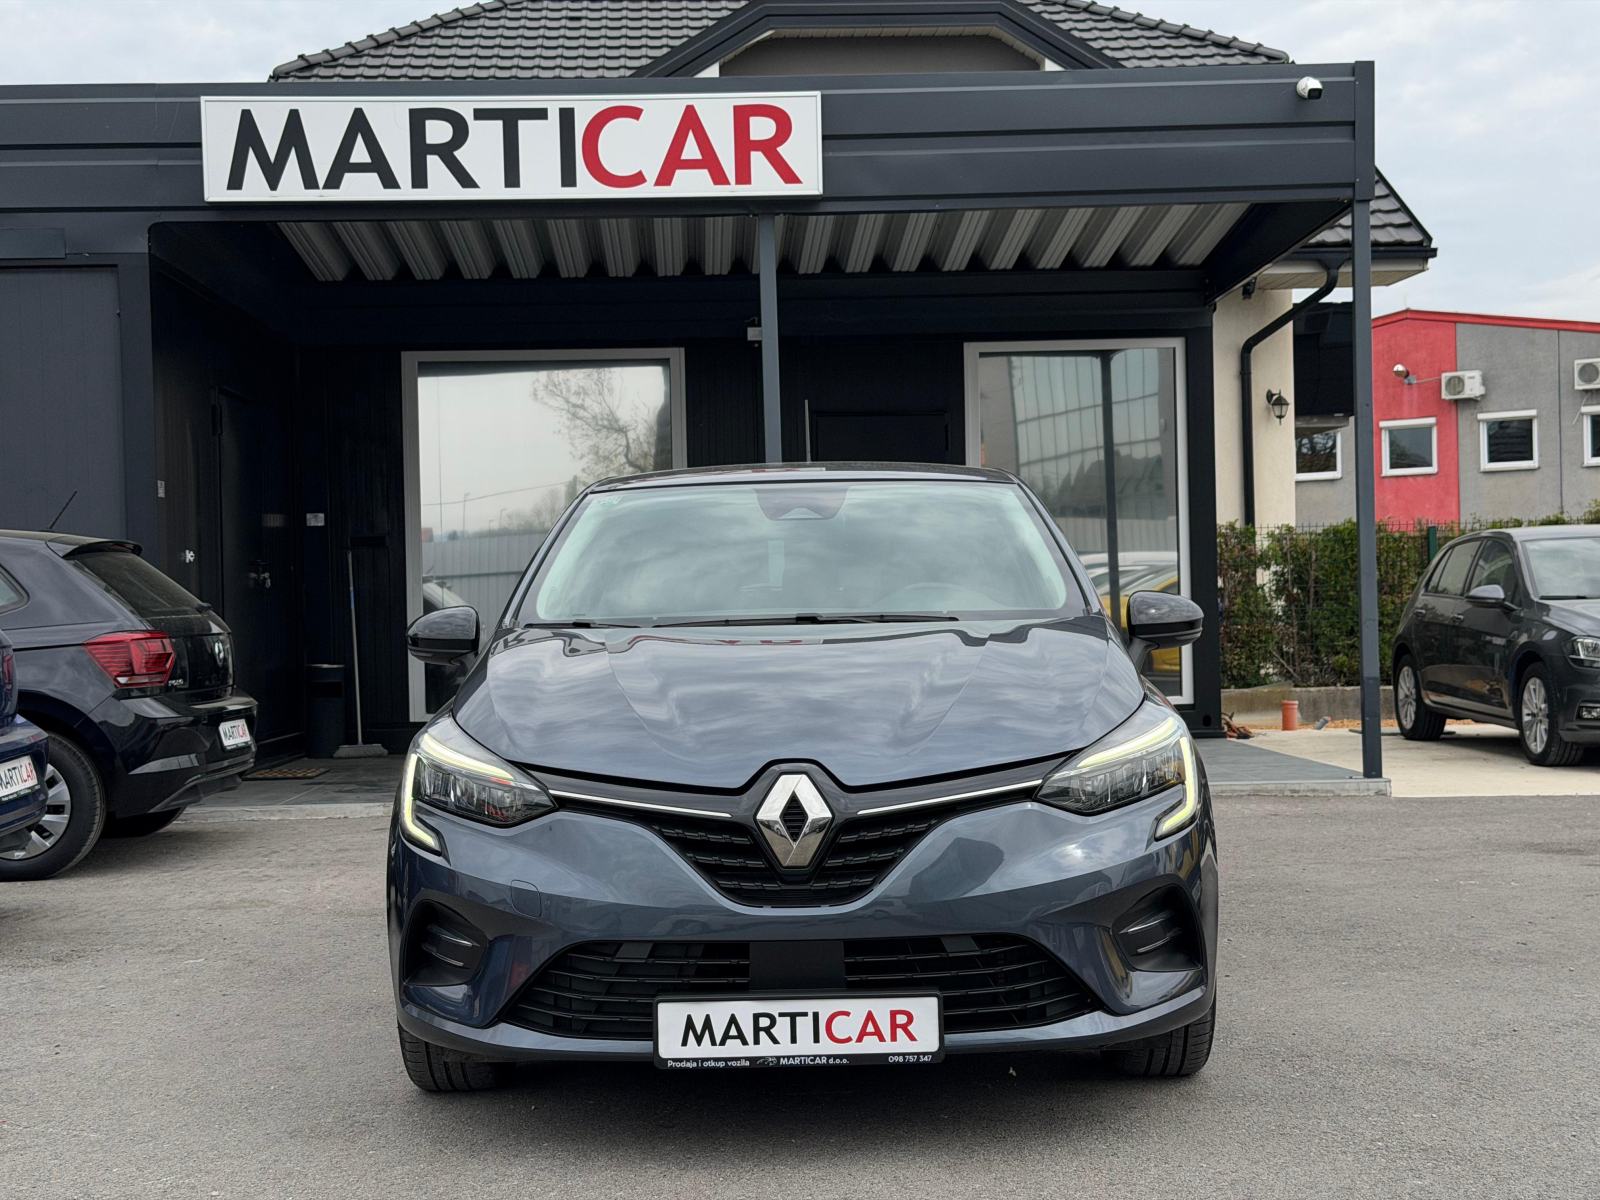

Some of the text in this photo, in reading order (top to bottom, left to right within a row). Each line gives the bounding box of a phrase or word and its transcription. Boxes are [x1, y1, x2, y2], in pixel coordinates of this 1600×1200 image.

[226, 103, 804, 191] MARTICAR
[680, 1009, 918, 1047] MARTICAR
[667, 1060, 697, 1069] Prodaja
[703, 1059, 726, 1068] otkup
[727, 1058, 750, 1067] vozila
[779, 1056, 850, 1066] MARTICAR d.o.o.
[888, 1054, 932, 1064] 098 757 347
